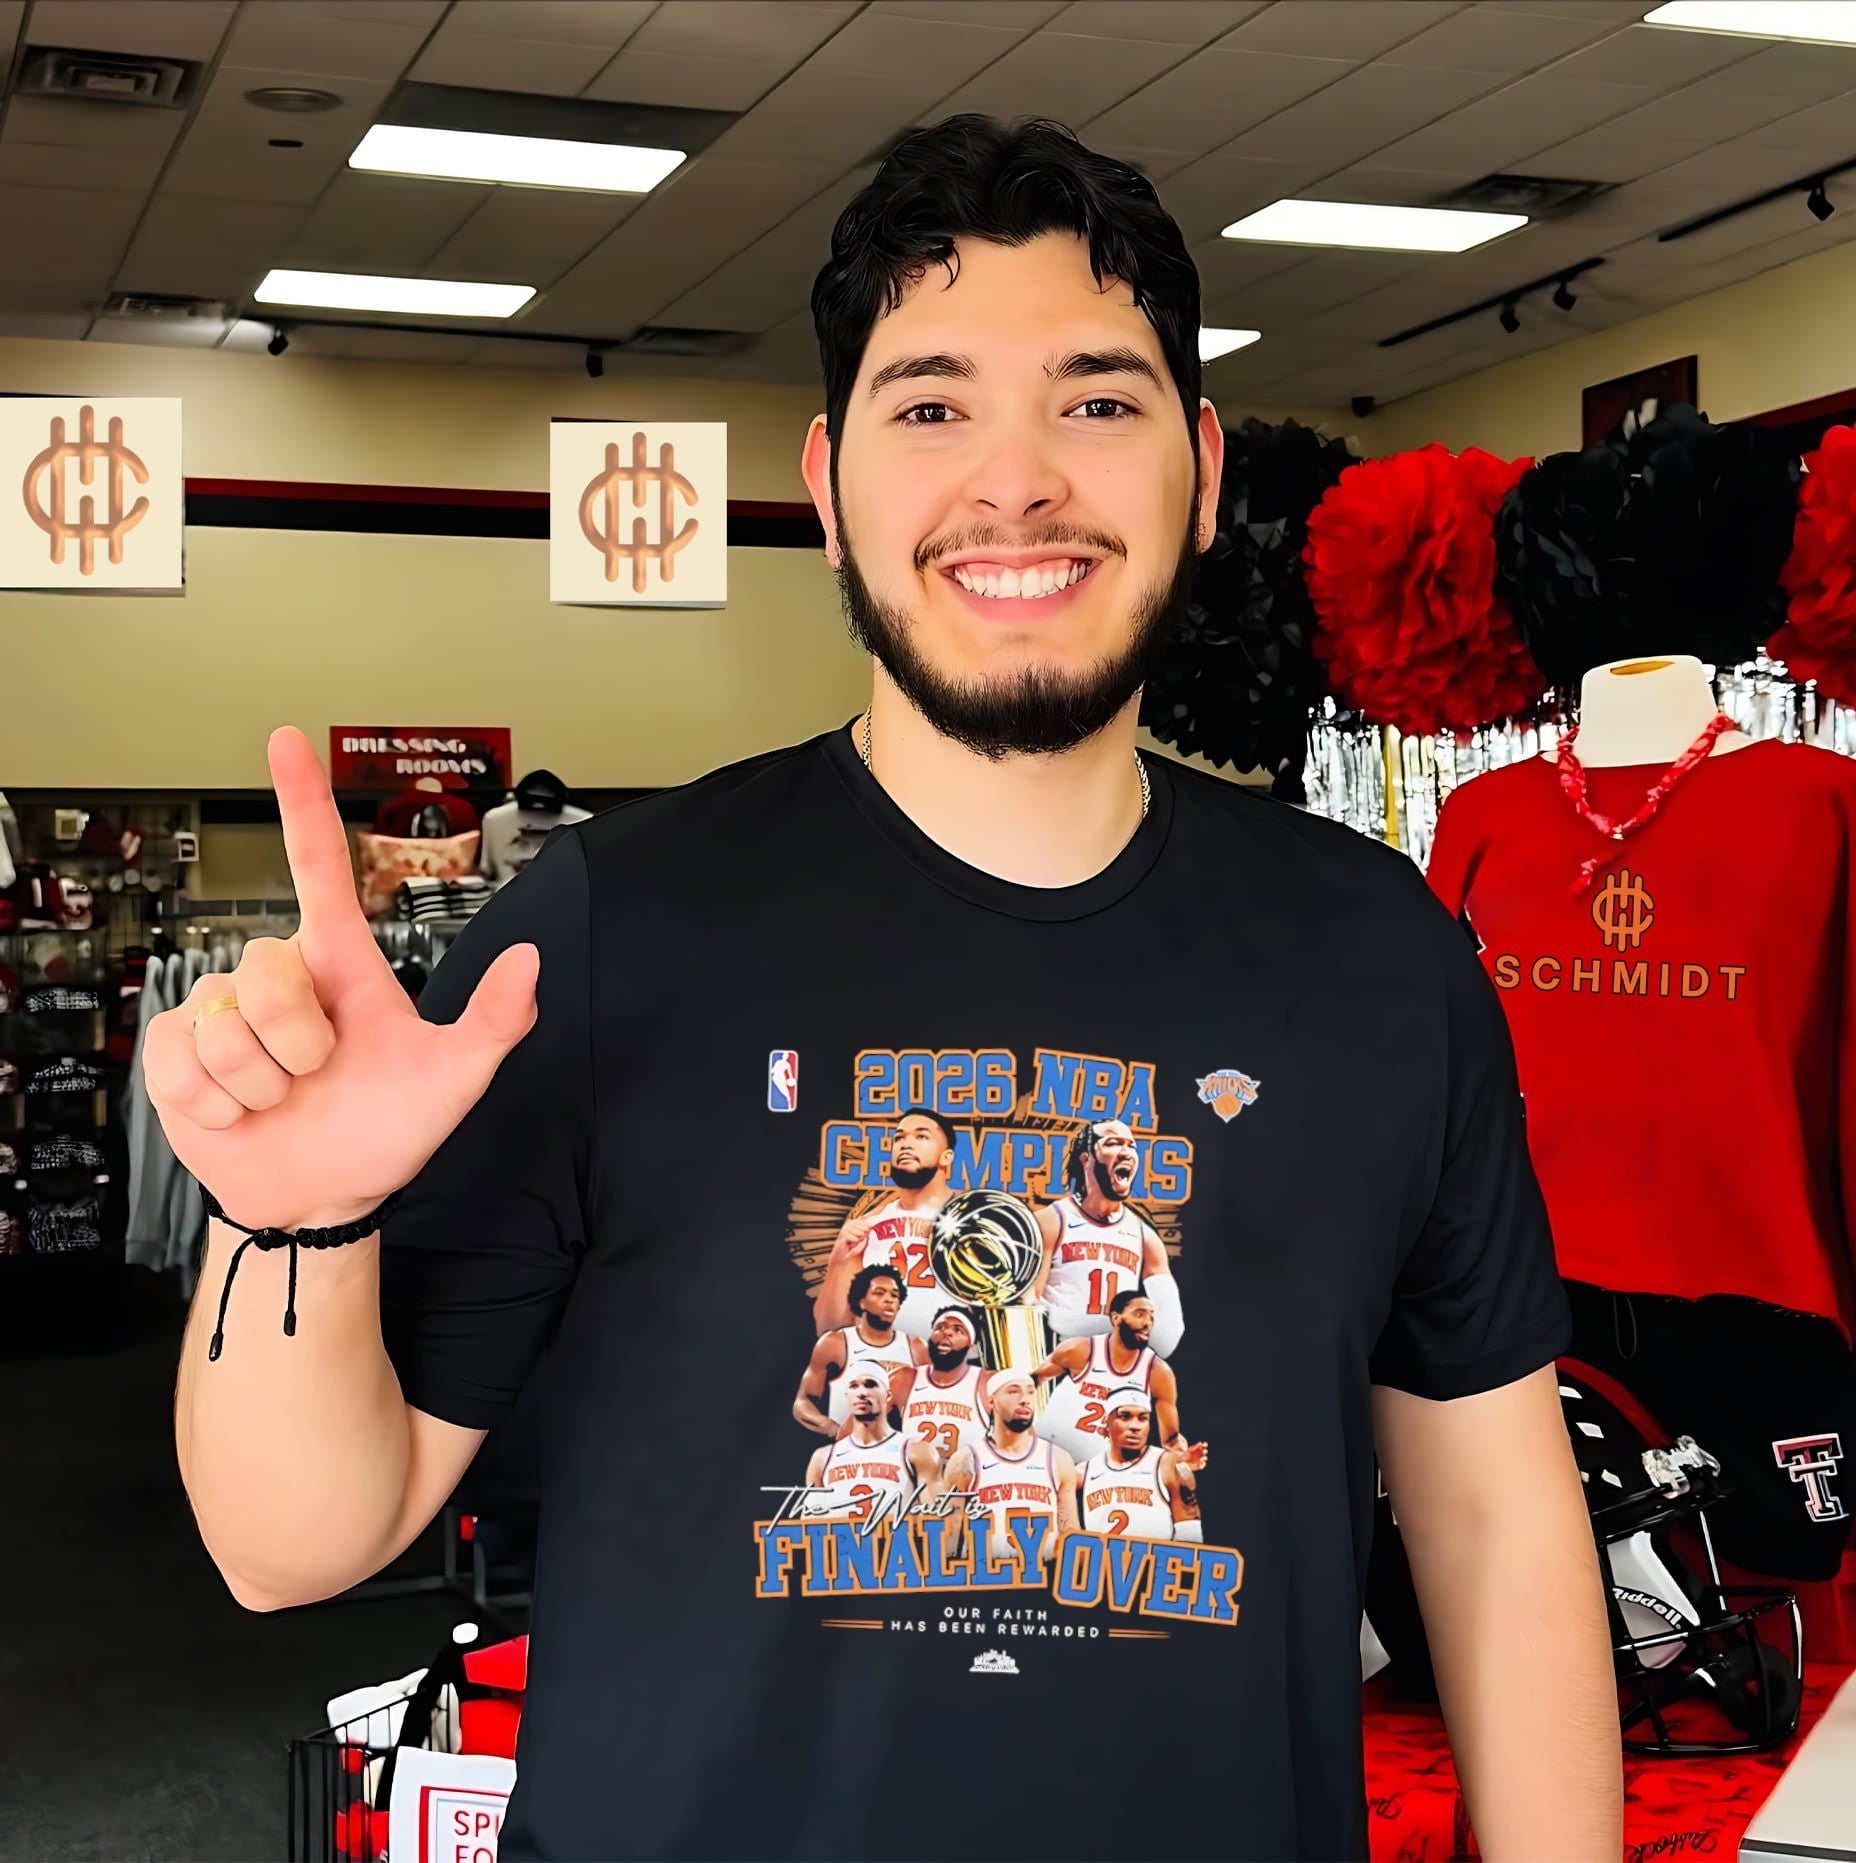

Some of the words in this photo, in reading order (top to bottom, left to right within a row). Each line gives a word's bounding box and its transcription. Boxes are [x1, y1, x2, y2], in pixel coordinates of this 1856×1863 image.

[396, 759, 487, 775] ROOMS
[1494, 954, 1746, 1000] SCHMIDT
[854, 1048, 1017, 1119] 2026
[1032, 1047, 1160, 1134] NBA
[1061, 1242, 1101, 1264] NEW
[1102, 1242, 1140, 1275] YORK
[1086, 1268, 1119, 1315] 11
[909, 1401, 937, 1418] NEW
[937, 1401, 972, 1422] YORK
[828, 1463, 859, 1485] NEW
[861, 1462, 901, 1483] YORK
[978, 1484, 1013, 1504] NEW
[1013, 1482, 1052, 1505] YORK
[1087, 1486, 1114, 1512] NEW
[1114, 1486, 1153, 1507] YORK
[760, 1482, 834, 1536] The
[835, 1482, 979, 1537] Wait
[753, 1512, 1053, 1598] FINALLY
[1052, 1527, 1245, 1626] OVER
[943, 1606, 981, 1619] OUR
[992, 1608, 1048, 1621] FAITH
[890, 1620, 927, 1632] HAS
[938, 1621, 986, 1634] BEEN
[997, 1623, 1100, 1638] REWARDED
